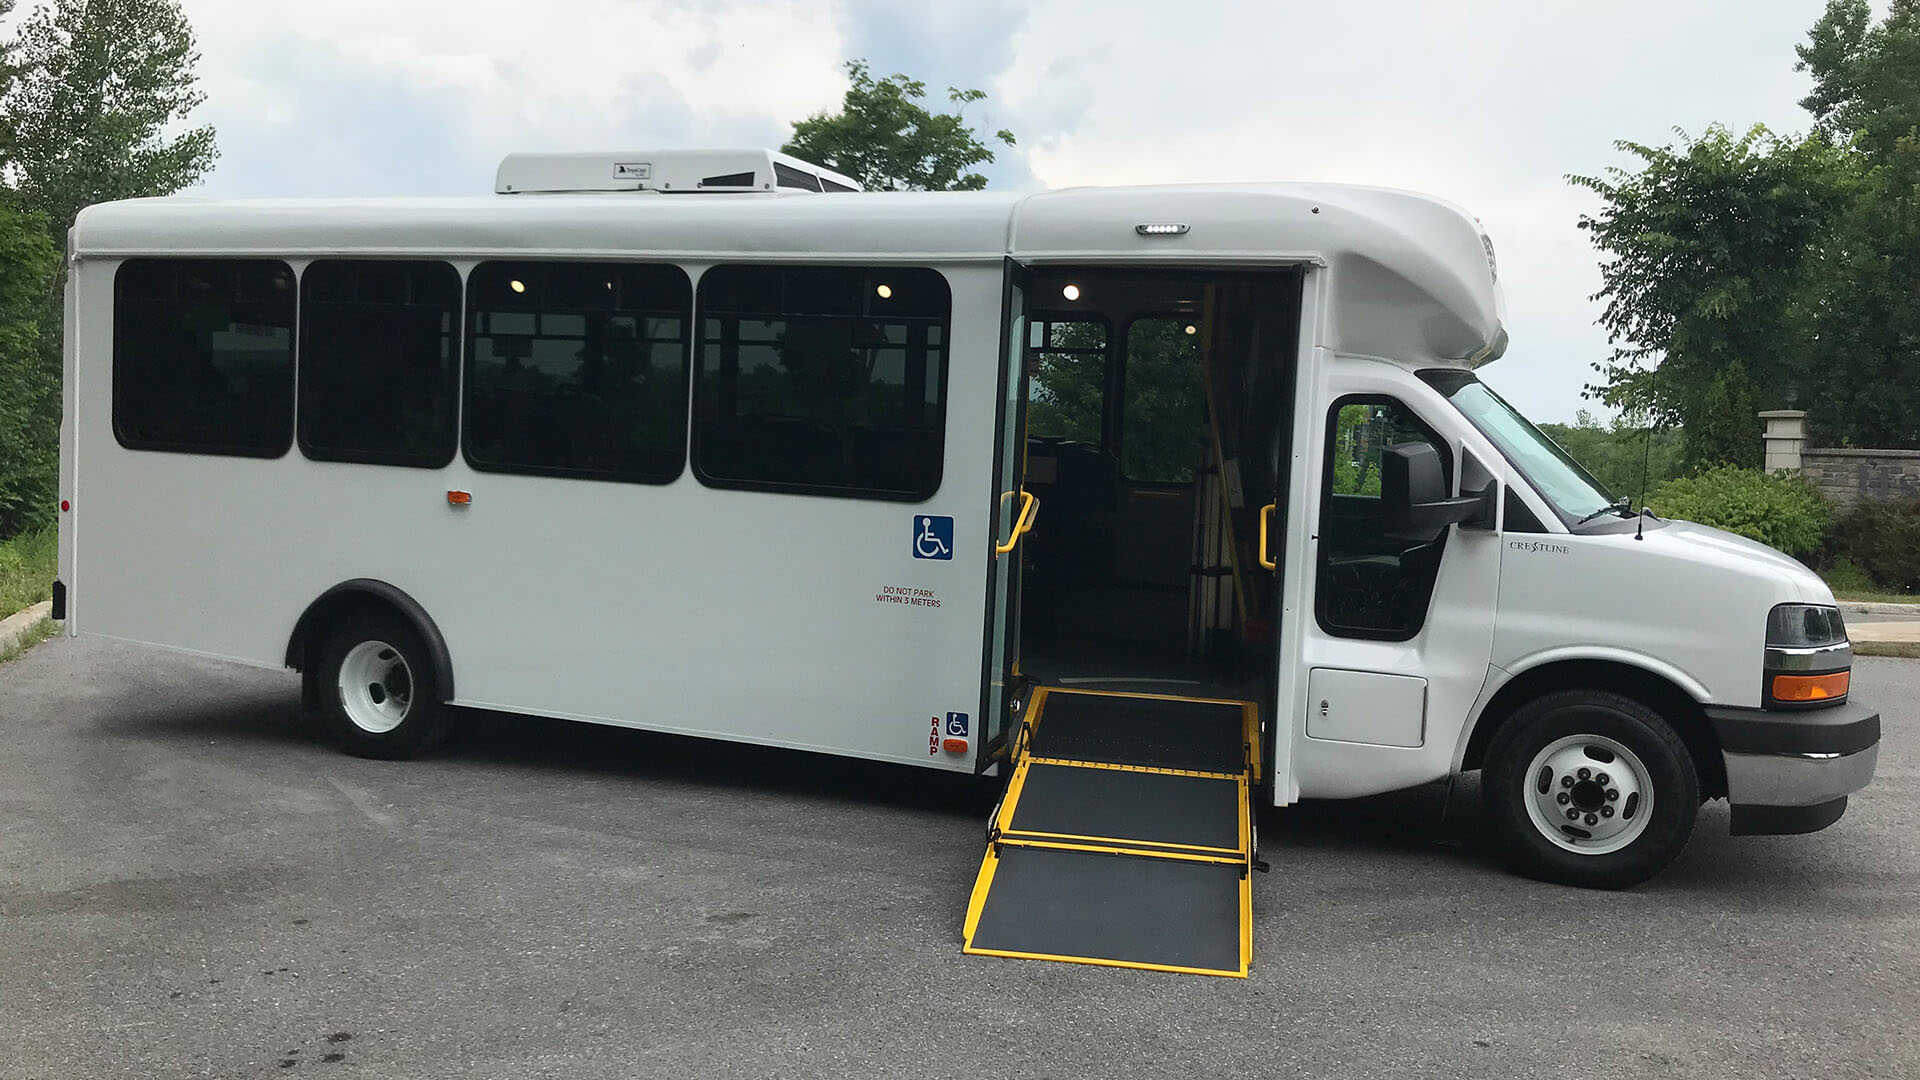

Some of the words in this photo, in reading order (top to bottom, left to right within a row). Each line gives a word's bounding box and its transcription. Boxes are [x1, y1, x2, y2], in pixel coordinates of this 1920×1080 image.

[1510, 541, 1570, 554] CRESTLINE
[883, 585, 895, 594] DO
[896, 587, 912, 595] NOT
[913, 588, 934, 598] PARK
[876, 594, 903, 604] WITHIN
[904, 596, 909, 605] 3
[911, 597, 941, 608] METERS
[929, 716, 940, 755] RAMP
